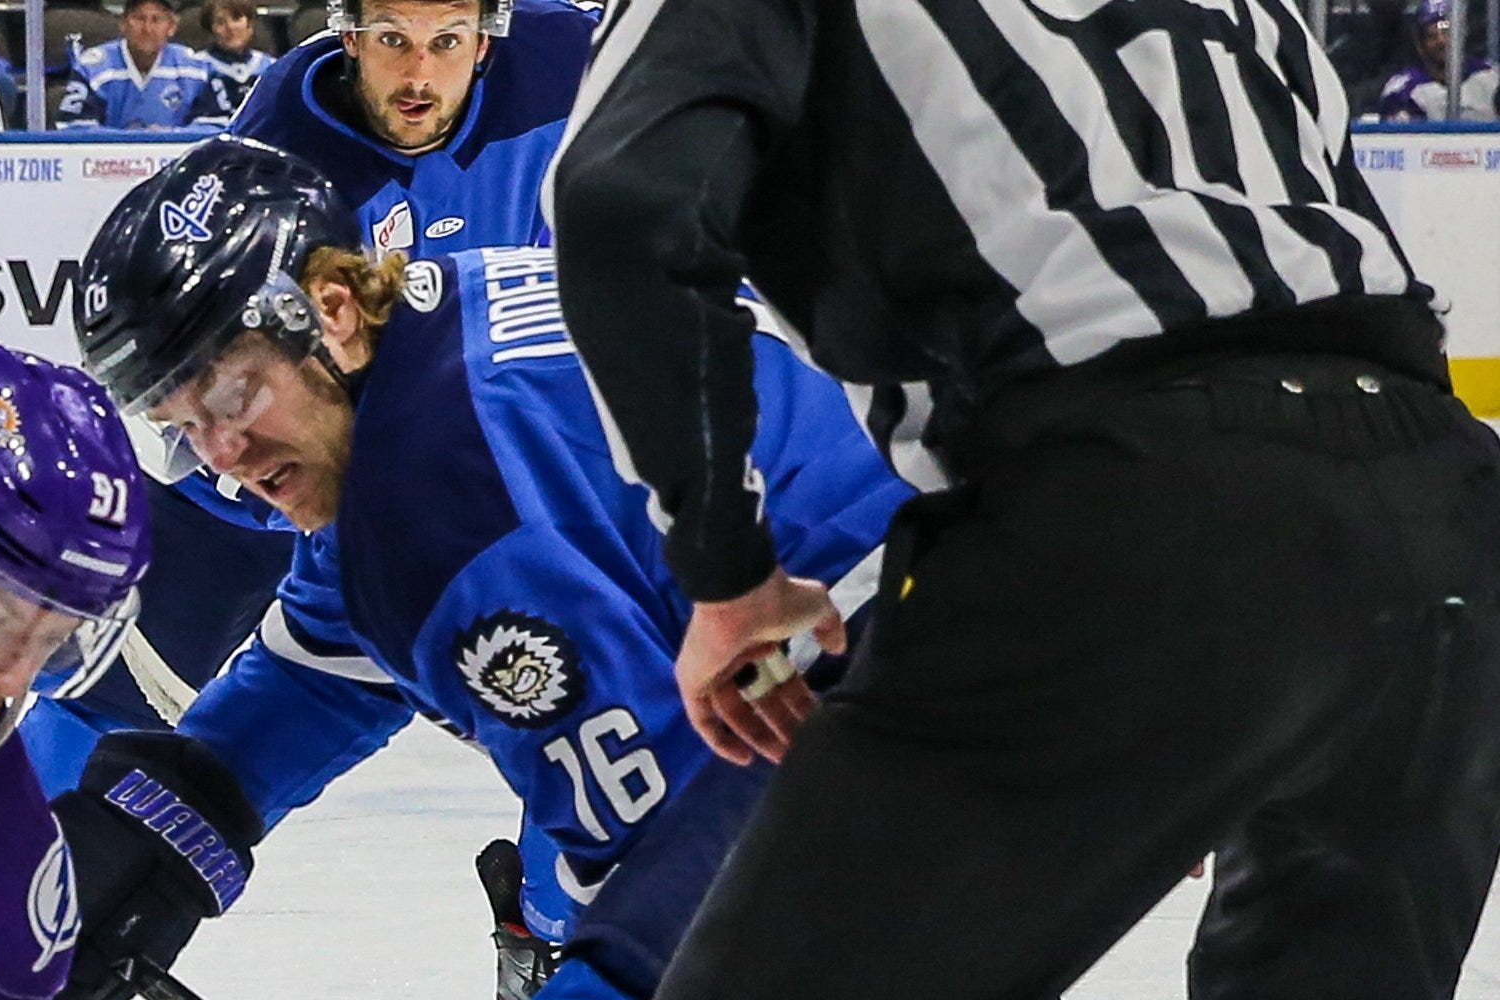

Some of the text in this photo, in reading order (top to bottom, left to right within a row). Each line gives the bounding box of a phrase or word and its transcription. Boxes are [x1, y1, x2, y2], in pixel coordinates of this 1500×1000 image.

[58, 81, 88, 114] 2
[19, 158, 62, 182] ZONE
[88, 471, 128, 525] 91
[543, 708, 667, 842] 16
